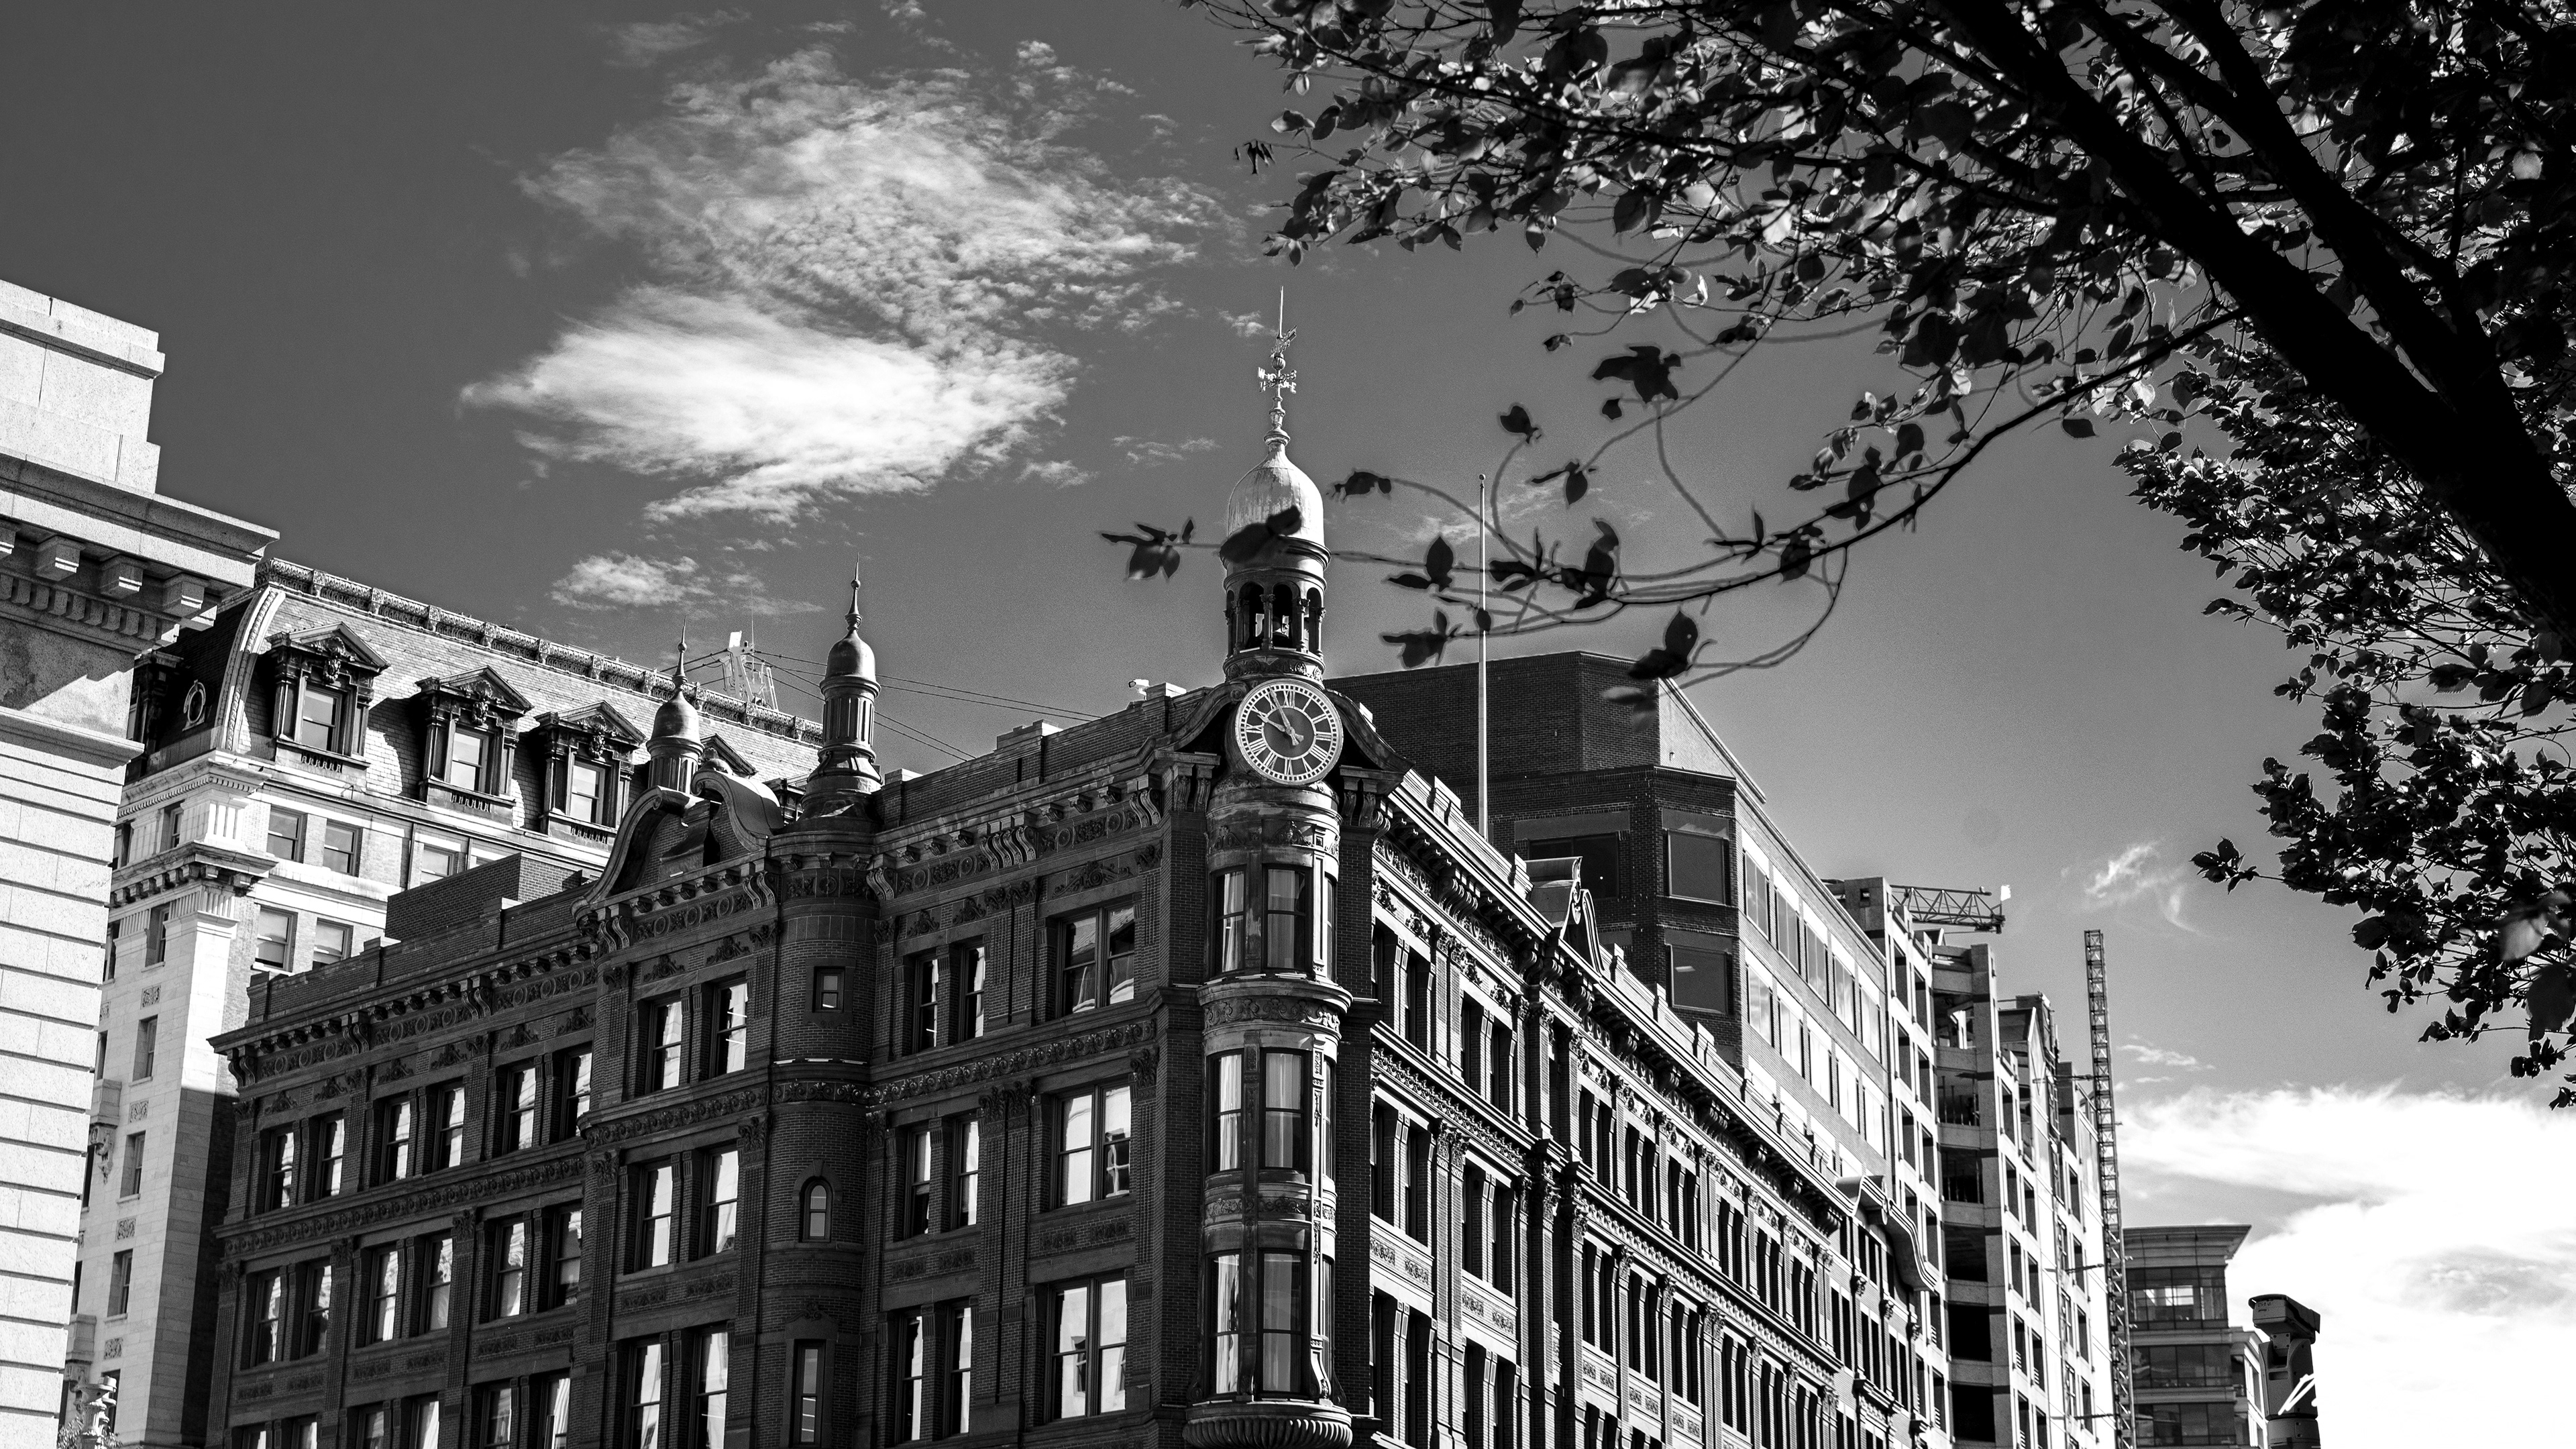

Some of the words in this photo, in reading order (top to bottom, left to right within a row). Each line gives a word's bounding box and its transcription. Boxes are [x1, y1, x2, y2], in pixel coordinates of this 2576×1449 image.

[1258, 367, 1265, 379] W
[1291, 382, 1297, 394] E
[1283, 690, 1295, 708] XII
[1302, 698, 1312, 712] I
[1311, 713, 1328, 724] II
[1246, 723, 1263, 734] IX
[1315, 731, 1332, 741] III
[1249, 737, 1267, 757] VIII
[1309, 744, 1329, 762] IIII
[1262, 751, 1278, 771] VII
[1285, 758, 1293, 775] VI
[1302, 757, 1313, 773] V
